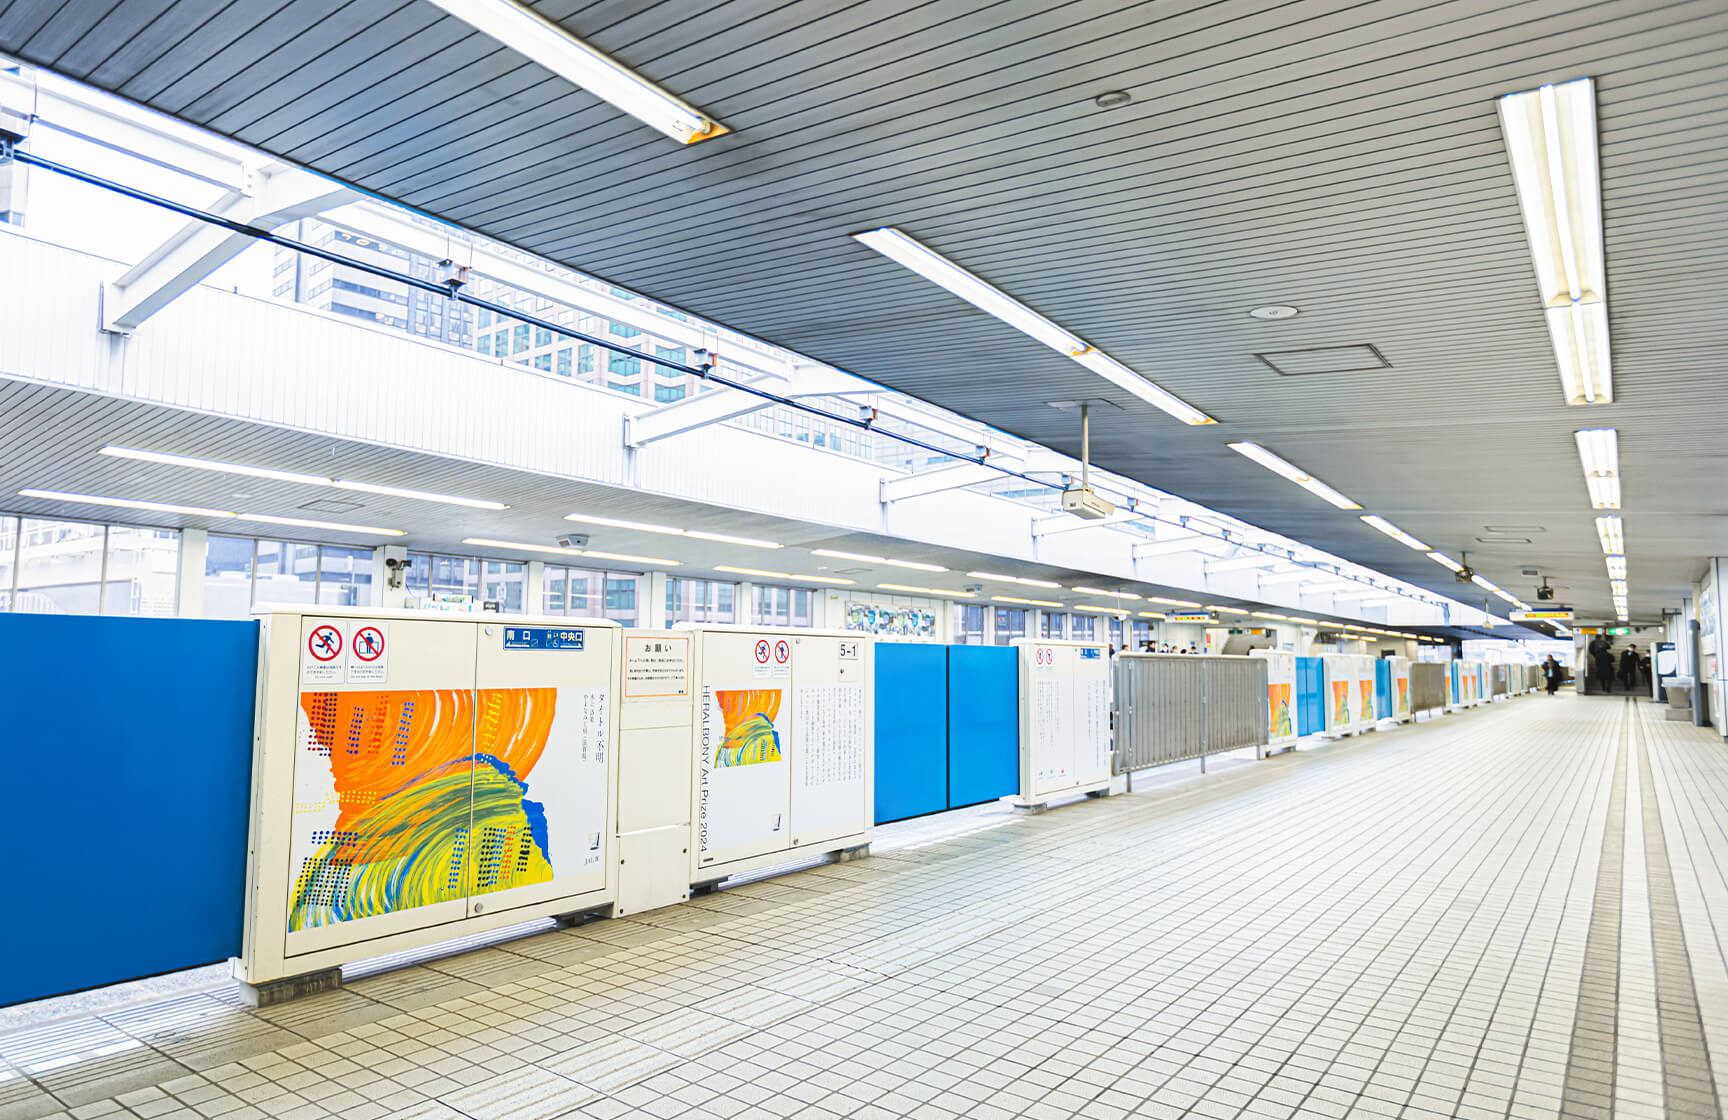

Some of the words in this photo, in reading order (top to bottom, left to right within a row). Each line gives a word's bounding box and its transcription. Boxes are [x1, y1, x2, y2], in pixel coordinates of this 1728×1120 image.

[560, 631, 583, 642] 中央口
[644, 643, 672, 653] お願い
[840, 643, 856, 657] 5-1
[702, 685, 711, 765] HERALBONY
[701, 768, 709, 786] Art
[700, 789, 708, 819] Prize
